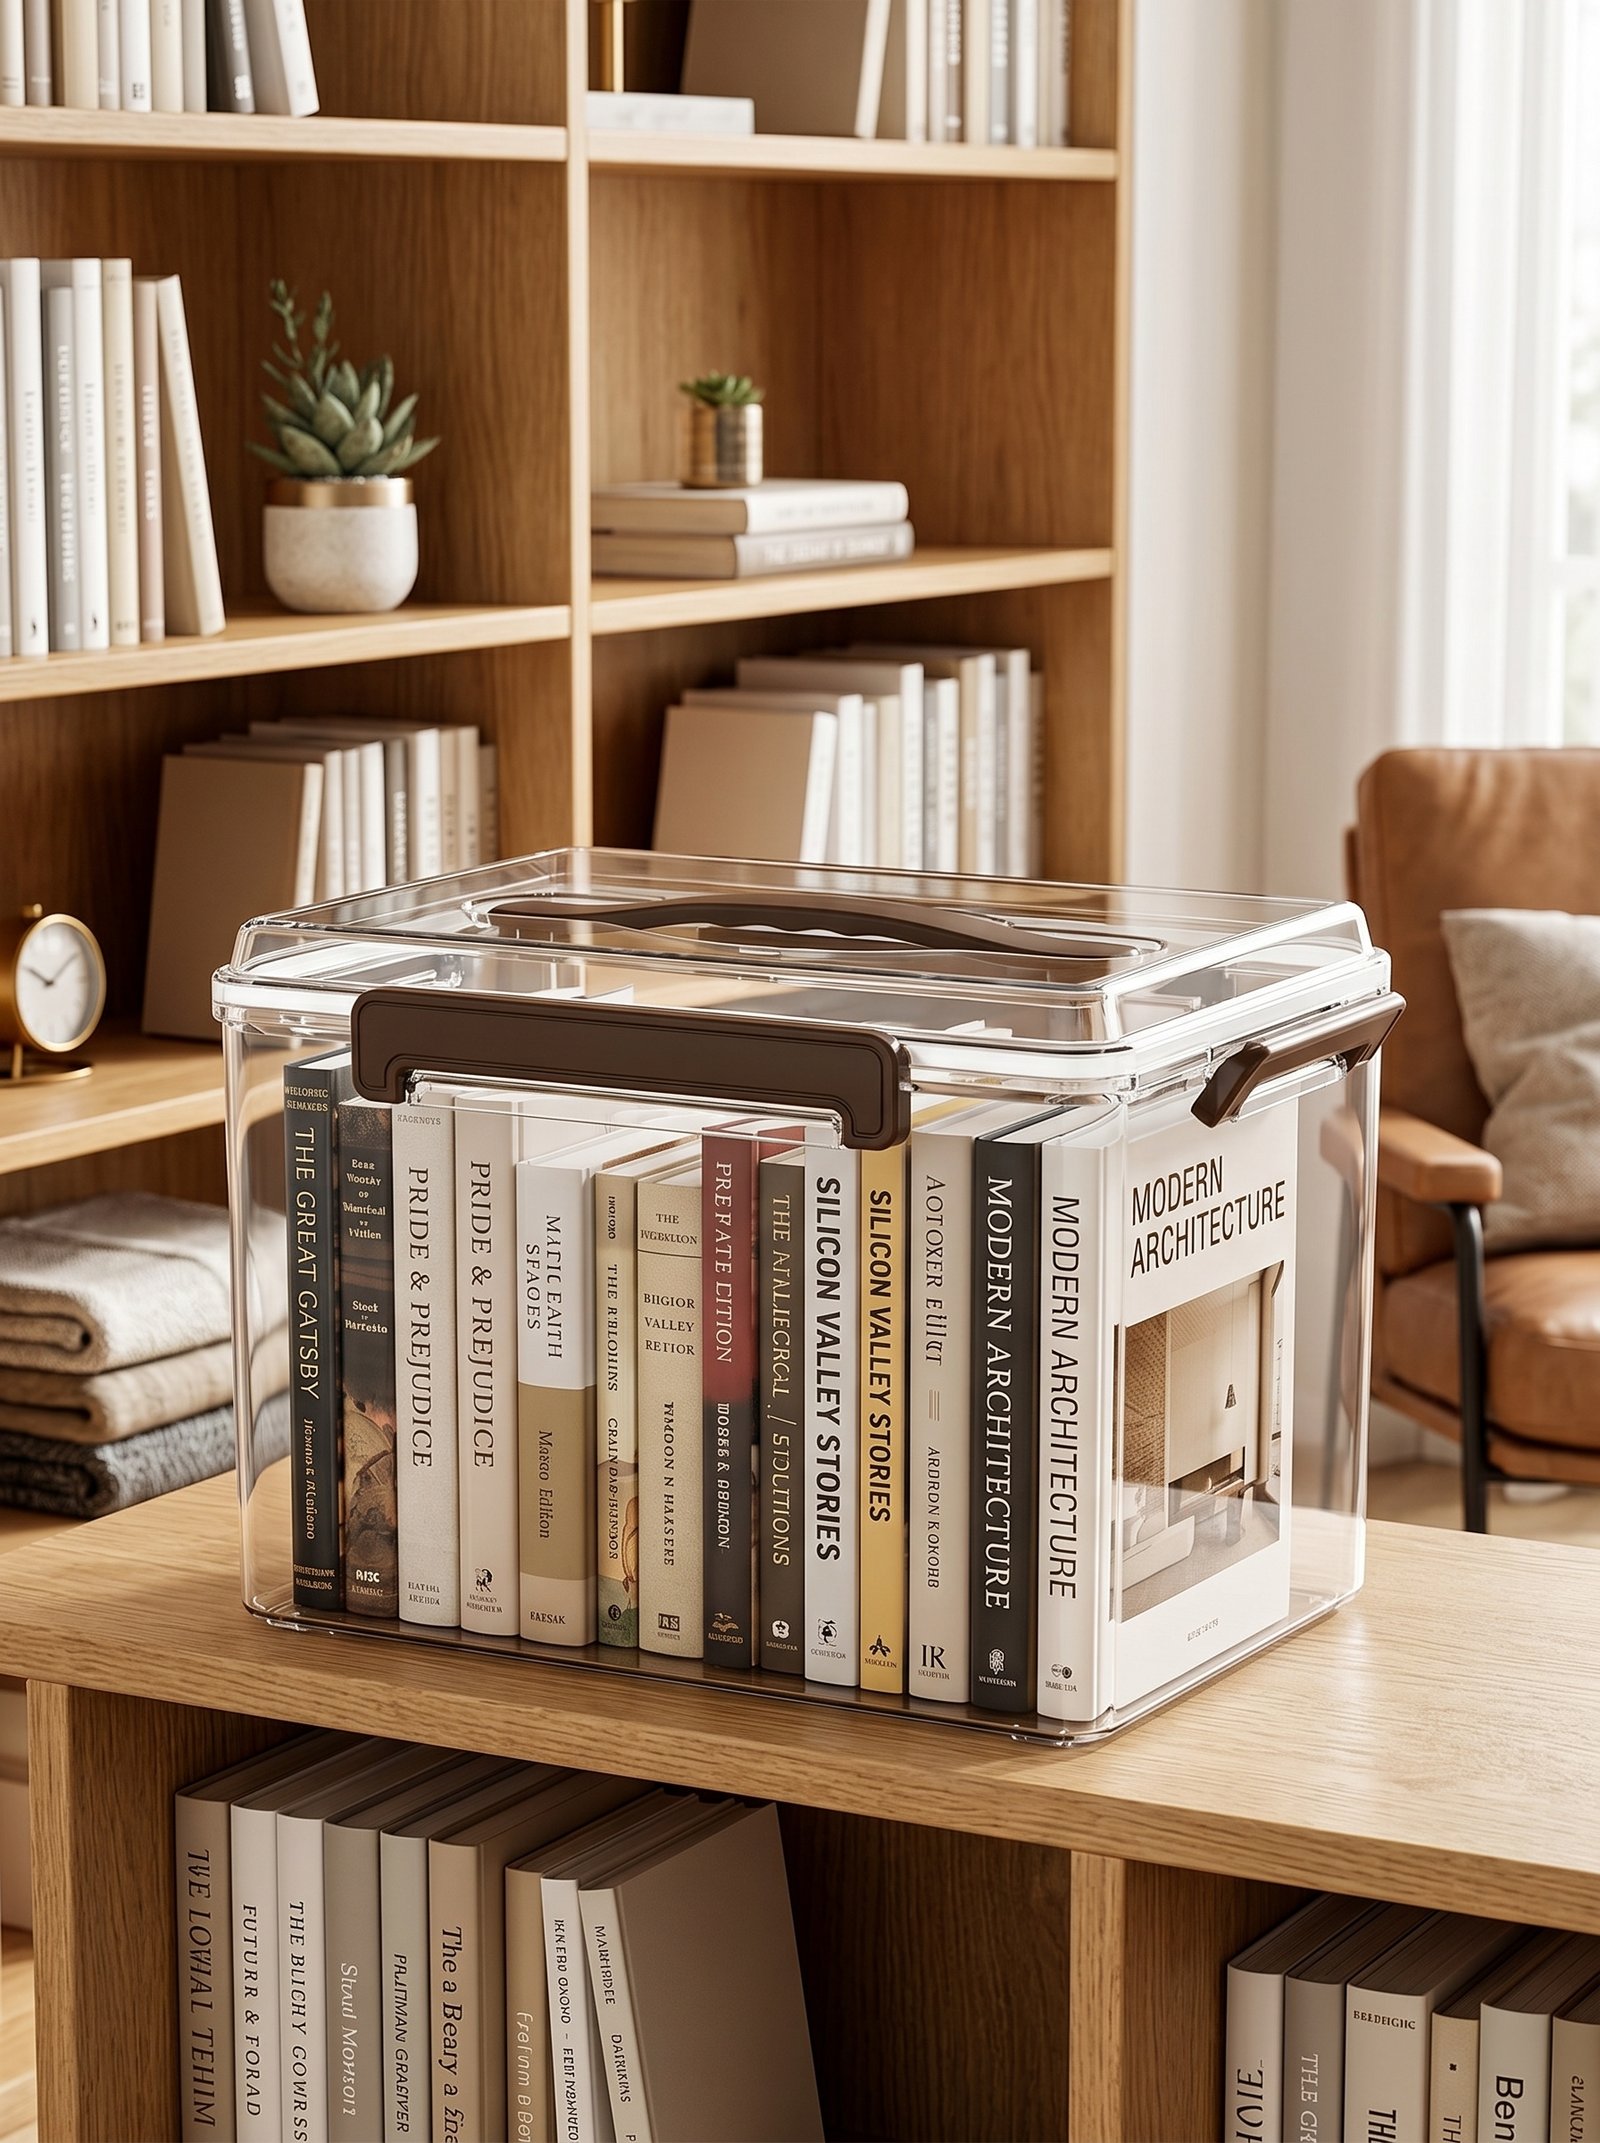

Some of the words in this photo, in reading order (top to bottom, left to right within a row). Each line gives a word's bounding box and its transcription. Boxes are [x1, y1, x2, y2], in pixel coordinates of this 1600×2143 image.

[294, 1127, 316, 1181] THE
[1131, 1155, 1224, 1227] MODERN
[296, 1191, 318, 1283] GREAT
[408, 1166, 431, 1261] PRIDE
[470, 1160, 493, 1255] PRIDE
[655, 1212, 680, 1225] THE
[772, 1194, 791, 1243] THE
[816, 1176, 841, 1301] SILICON
[869, 1189, 892, 1298] SILICON
[986, 1175, 1014, 1333] MODERN
[1130, 1179, 1286, 1280] ARCHITECTURE
[410, 1271, 431, 1292] &
[471, 1265, 492, 1287] &
[607, 1264, 618, 1300] THE
[1051, 1195, 1080, 1341] MODERN
[297, 1290, 320, 1400] GATSBY
[644, 1316, 695, 1333] VALLEY
[816, 1311, 841, 1427] VALLEY
[869, 1306, 892, 1407] VALLEY
[406, 1302, 433, 1469] PREJUDICE
[468, 1296, 495, 1469] PREJUDICE
[816, 1434, 841, 1562] STORIES
[869, 1413, 892, 1523] STORIES
[984, 1341, 1014, 1611] ARCHITECTURE
[1049, 1349, 1080, 1600] ARCHITECTURE
[288, 1900, 305, 1948] THE
[441, 1926, 463, 1973] The
[244, 2008, 259, 2026] &
[438, 2001, 463, 2076] Beary
[245, 2034, 262, 2118] FORAD
[1300, 2053, 1319, 2104] THE
[1495, 2075, 1525, 2142] Ben
